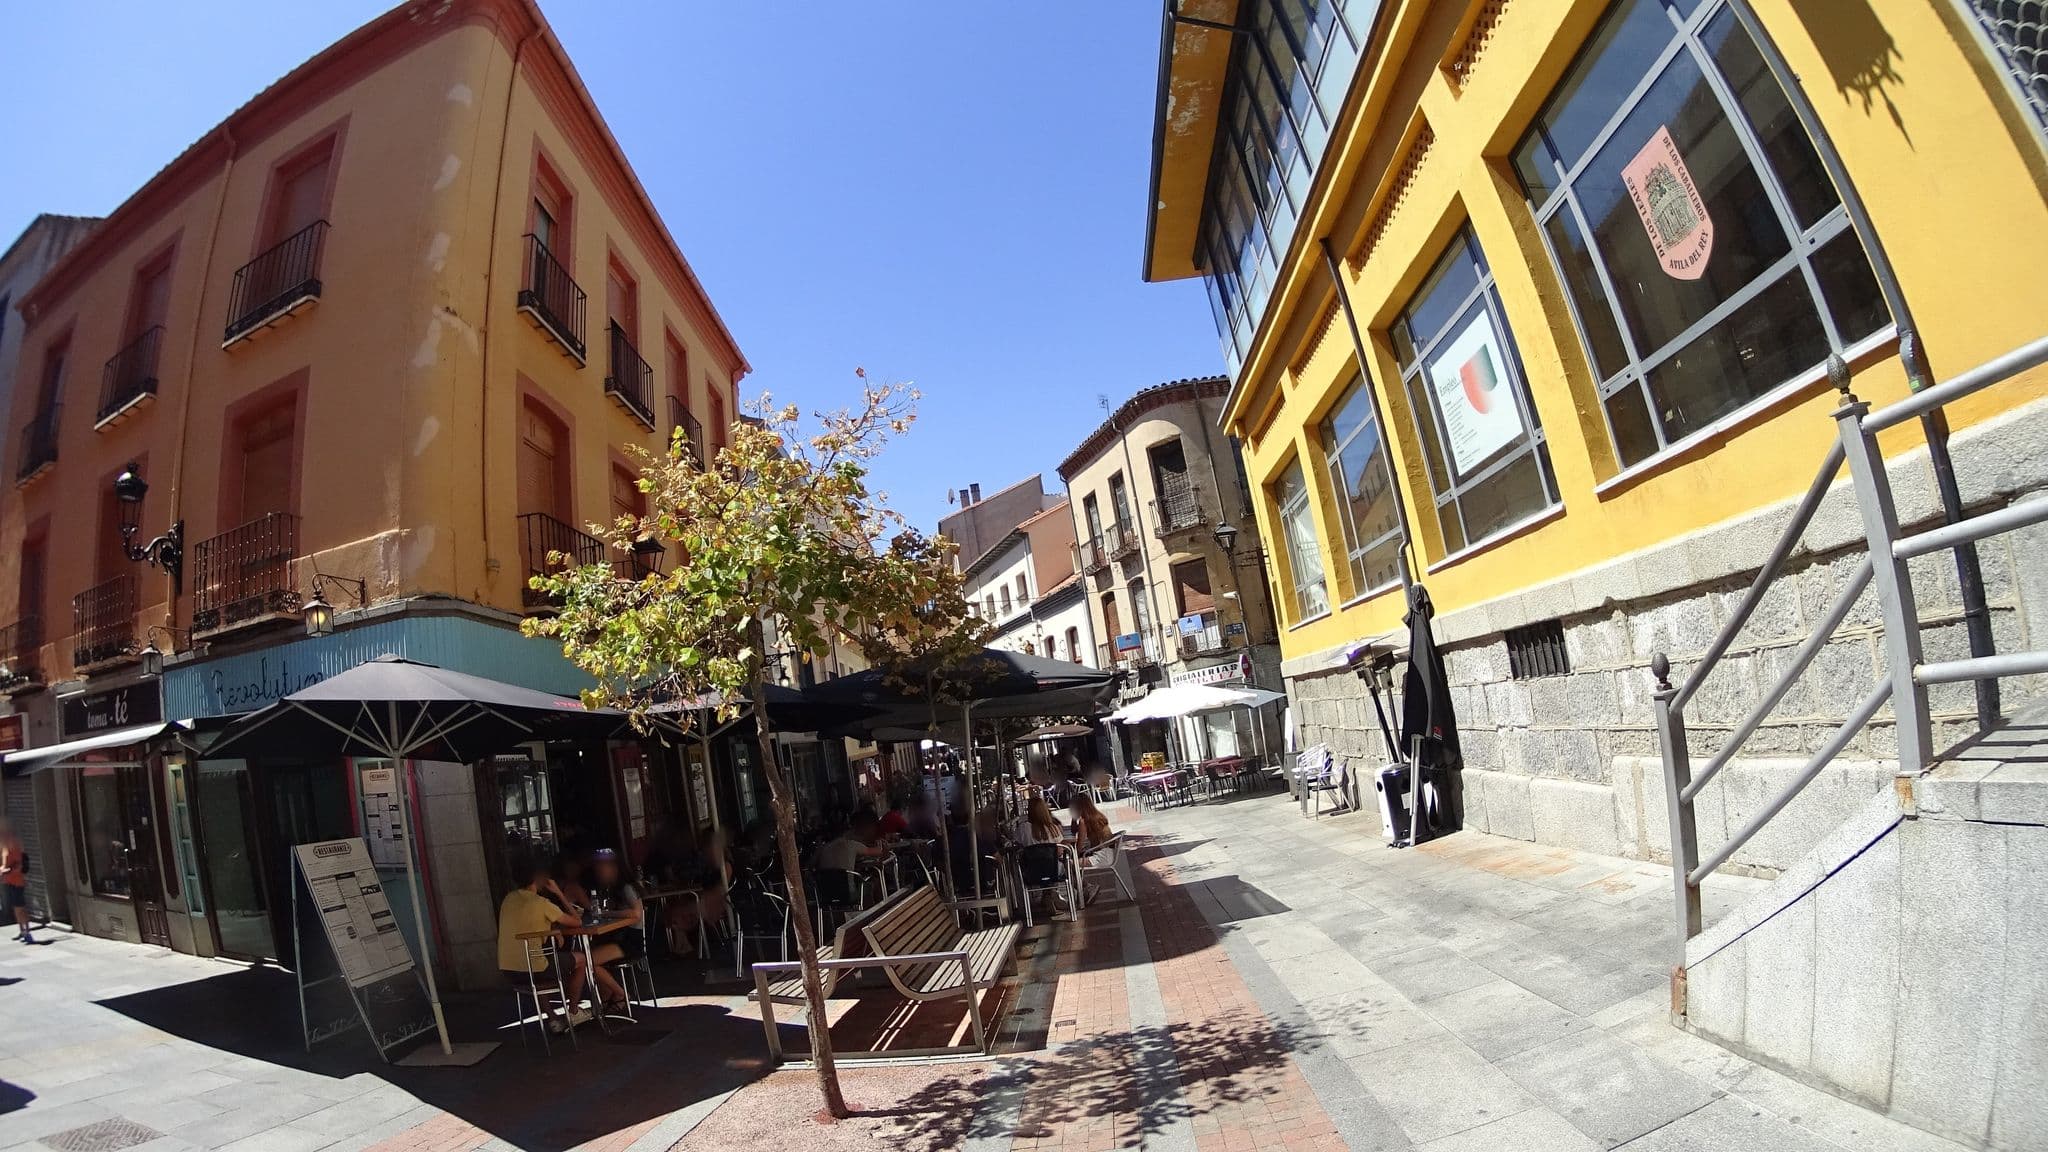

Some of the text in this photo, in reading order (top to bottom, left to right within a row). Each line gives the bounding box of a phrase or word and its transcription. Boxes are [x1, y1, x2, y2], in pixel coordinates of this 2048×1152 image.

[1626, 176, 1665, 258] DE LOS LEALES
[1663, 136, 1707, 222] DE LOS CABALLEROS
[1689, 248, 1702, 265] DEL
[1699, 229, 1709, 254] REY
